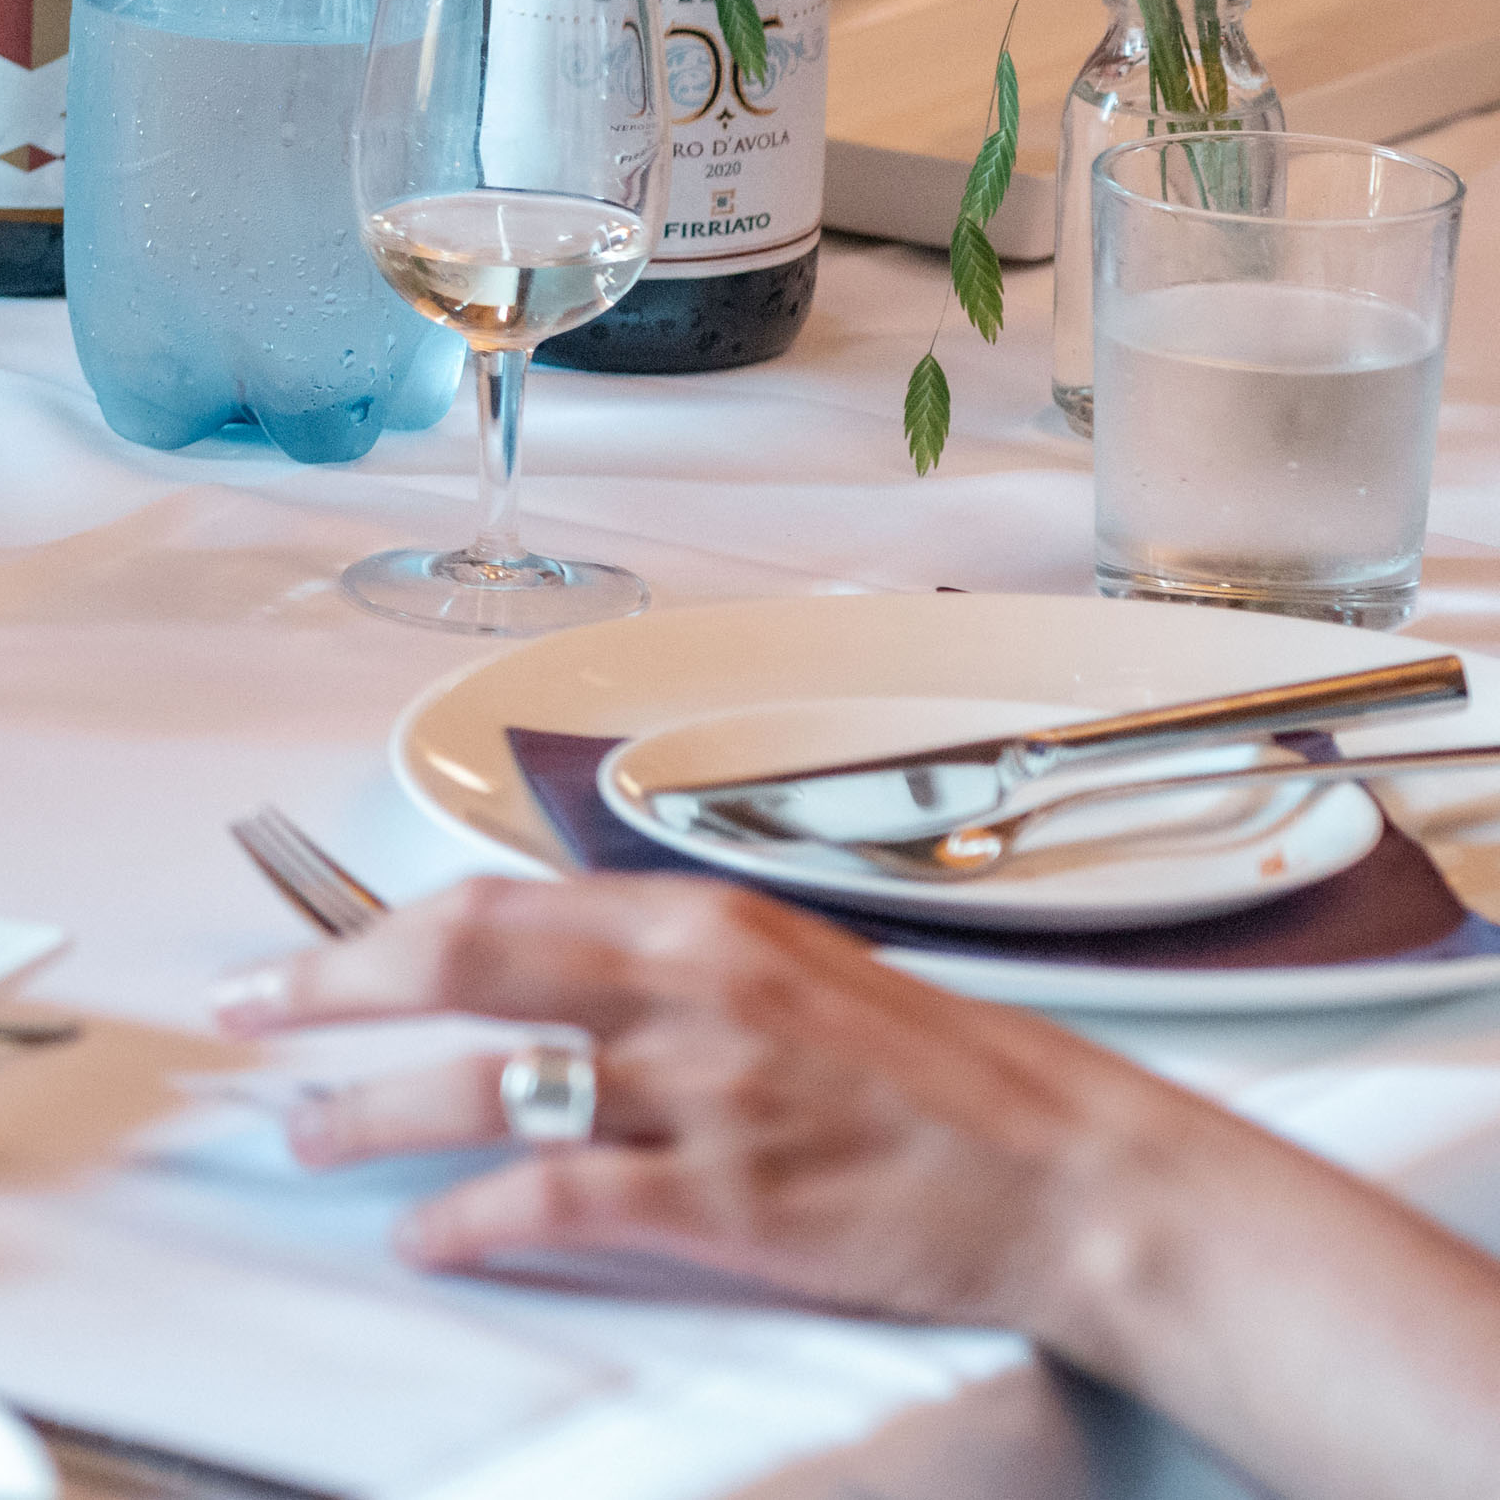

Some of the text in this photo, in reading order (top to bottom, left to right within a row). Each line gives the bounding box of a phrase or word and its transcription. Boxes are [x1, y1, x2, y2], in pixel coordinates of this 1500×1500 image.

[673, 141, 704, 159] RO
[712, 129, 790, 155] D'AVOLA
[705, 160, 742, 178] 2020
[663, 212, 771, 239] FIRRIATO
